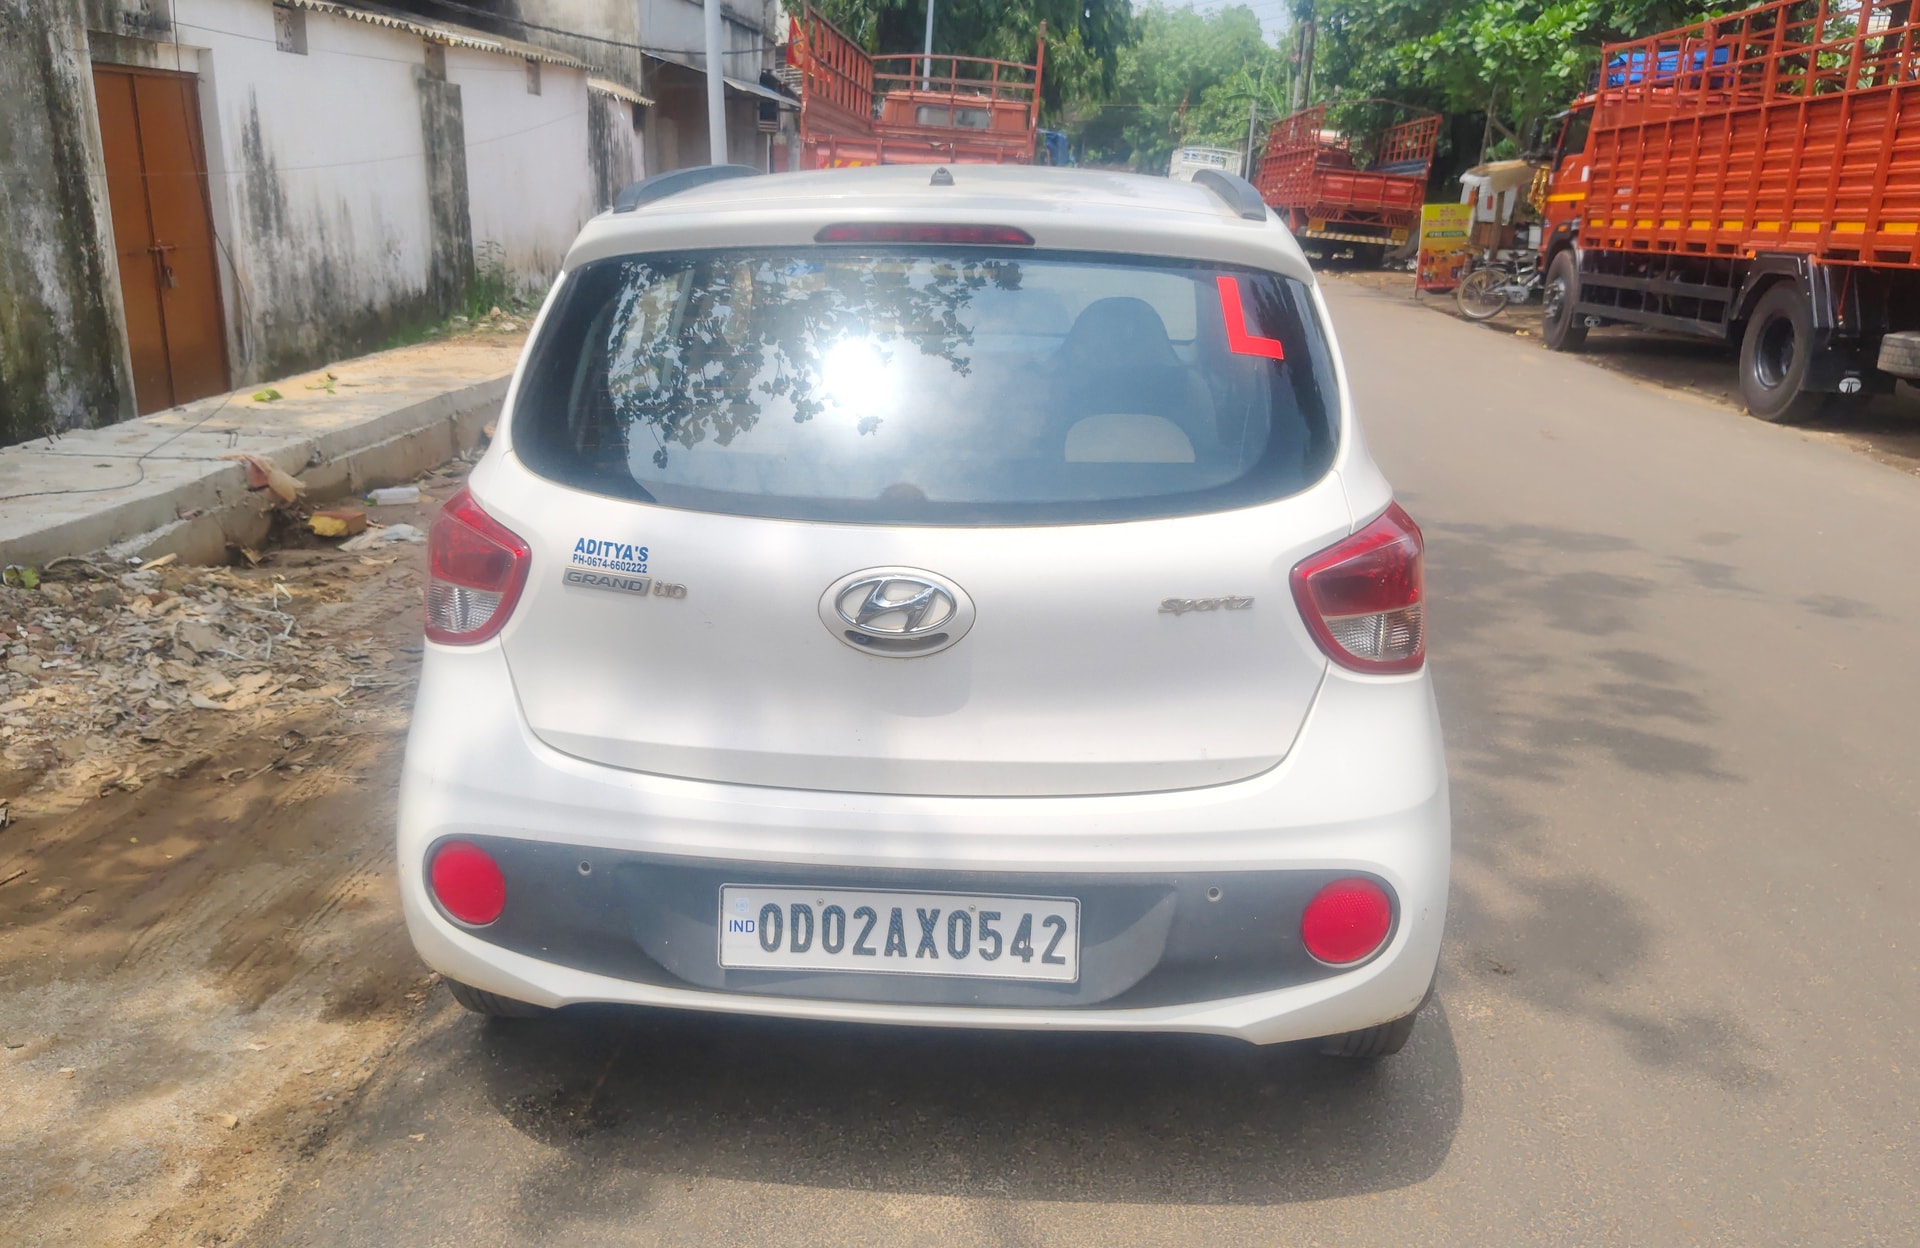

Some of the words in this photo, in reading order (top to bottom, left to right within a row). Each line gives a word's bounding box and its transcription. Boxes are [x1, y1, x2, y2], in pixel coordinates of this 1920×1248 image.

[1216, 276, 1284, 360] L
[572, 553, 648, 574] PH-0674-6602222
[574, 537, 649, 562] ADITYA'S
[567, 571, 643, 592] GRAND
[653, 579, 688, 600] i10
[729, 919, 755, 933] IND
[758, 902, 1067, 965] OD02AX0542
